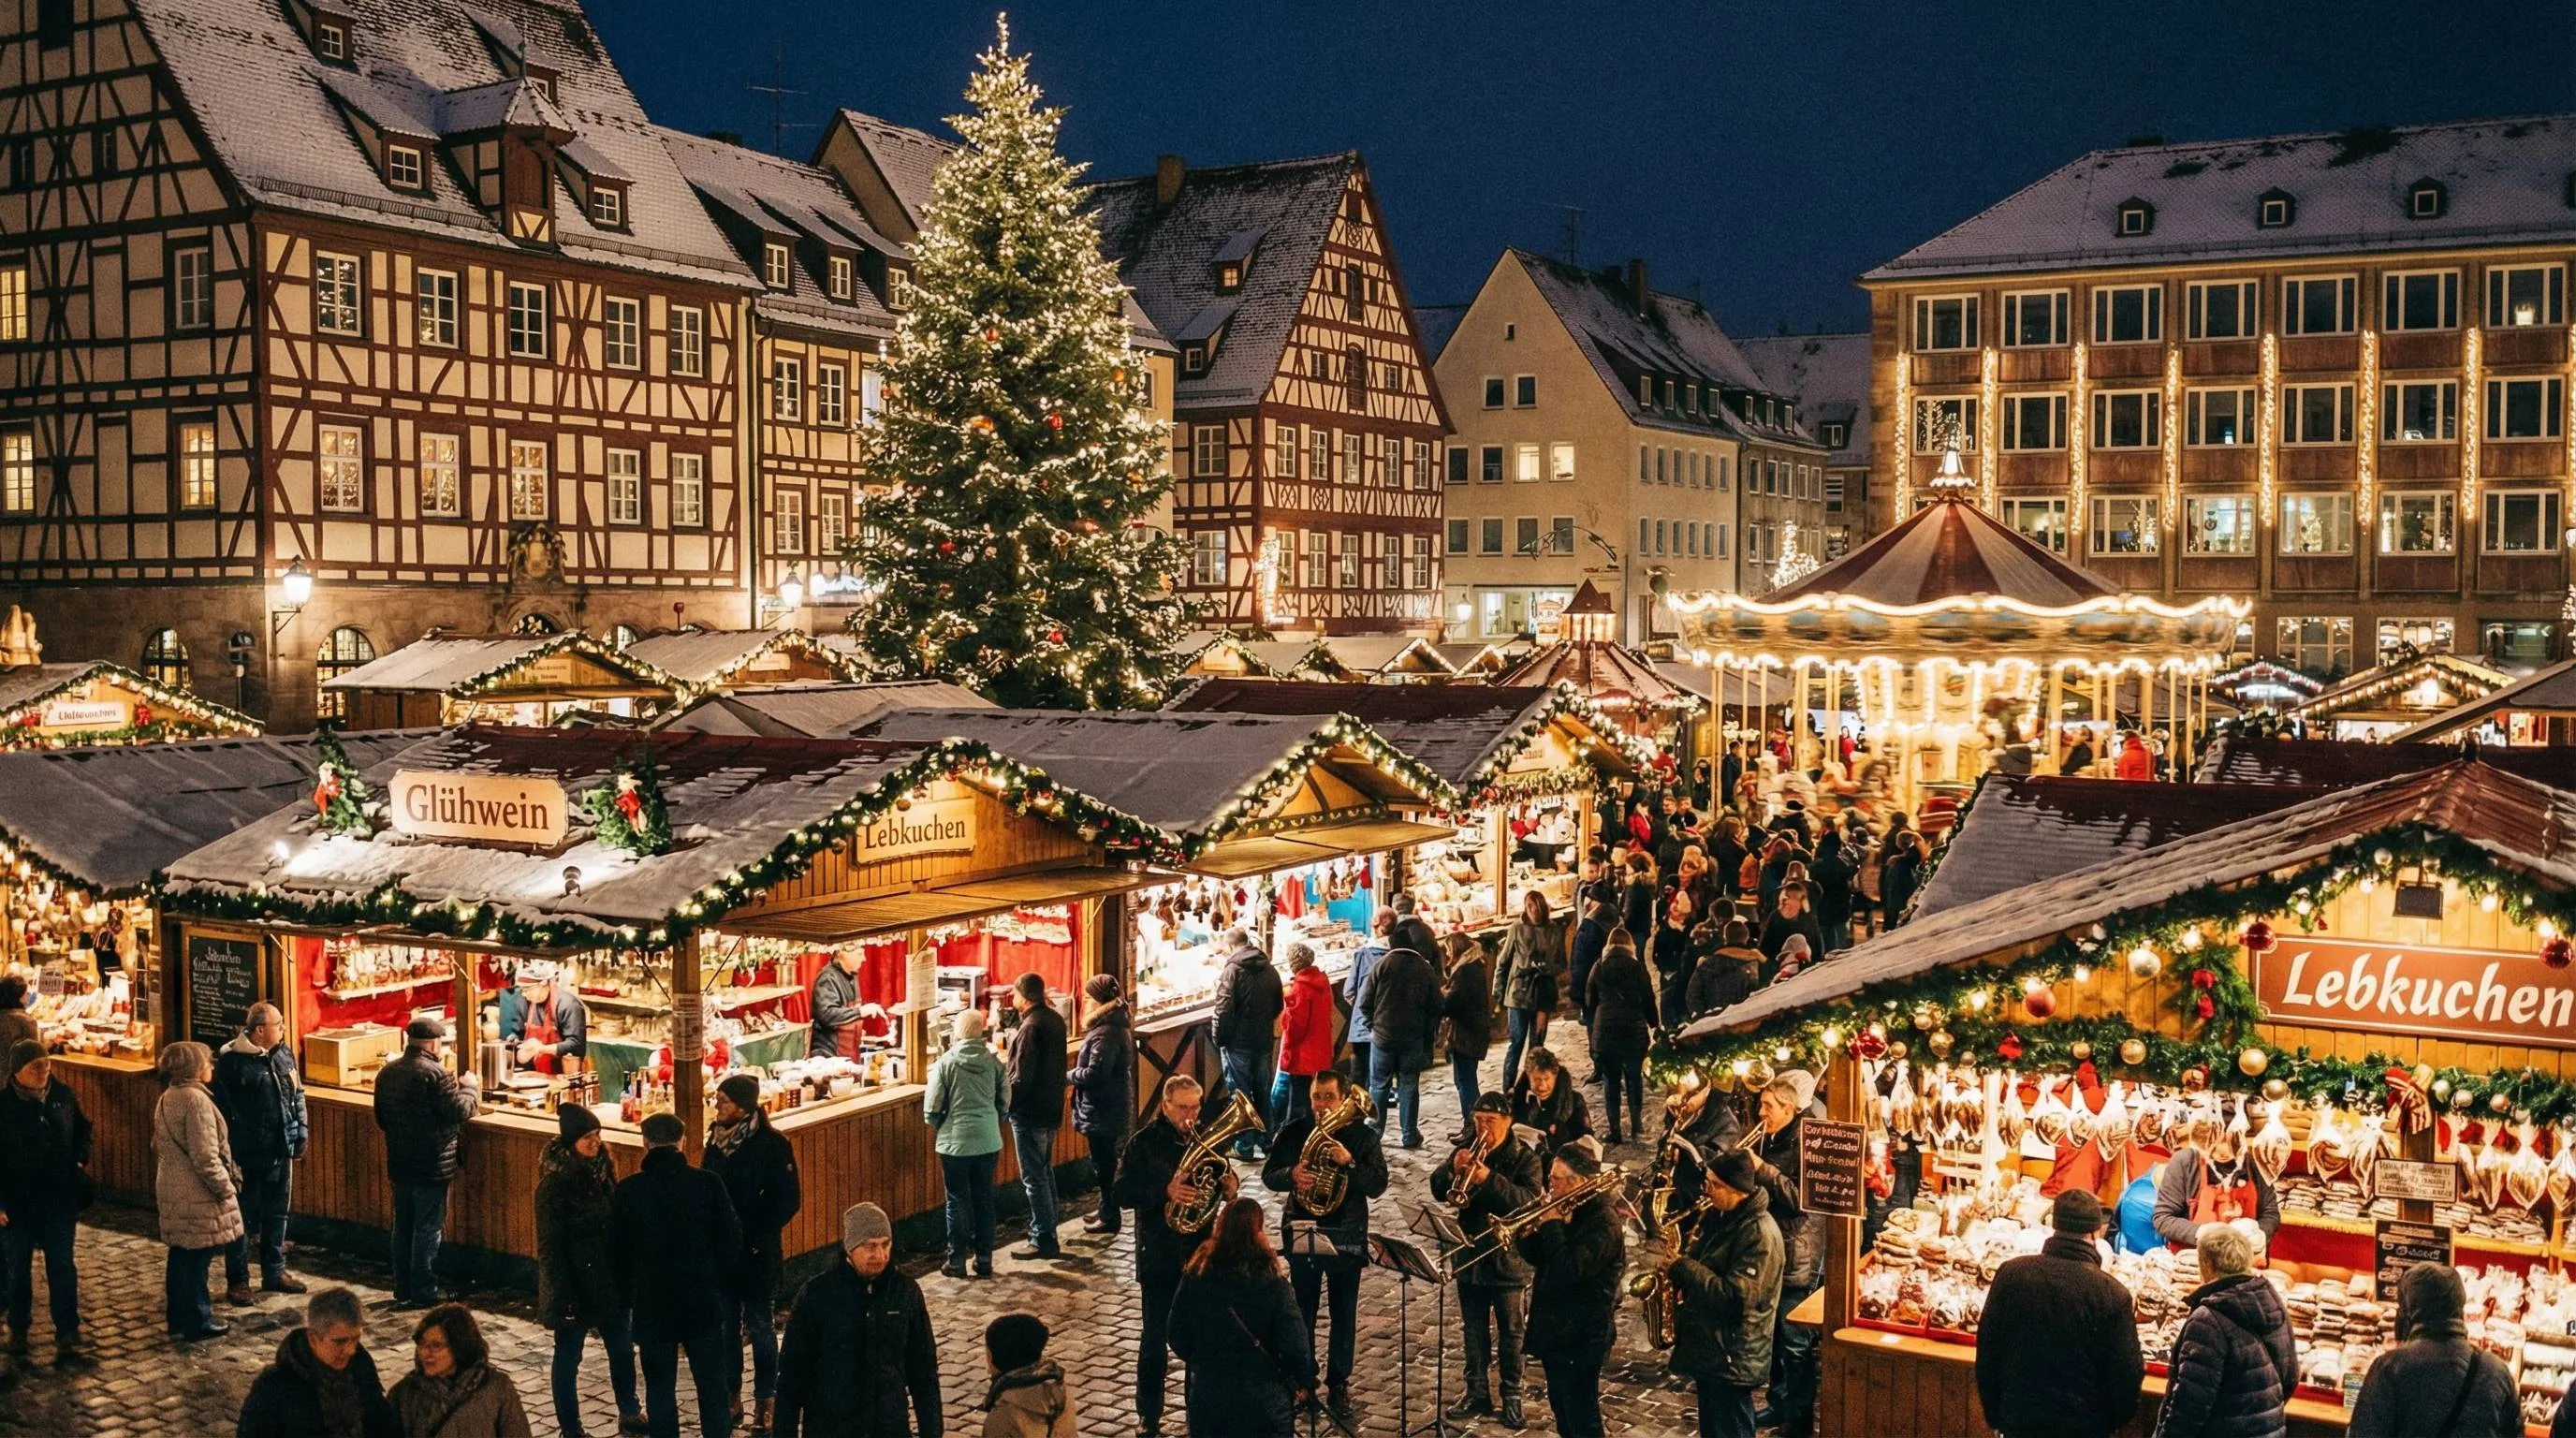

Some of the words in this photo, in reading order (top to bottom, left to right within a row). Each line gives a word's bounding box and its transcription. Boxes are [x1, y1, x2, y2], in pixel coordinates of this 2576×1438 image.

[405, 784, 549, 830] Glühwein
[864, 814, 966, 849] Lebkuchen
[2281, 950, 2575, 1027] Lebkuchen
